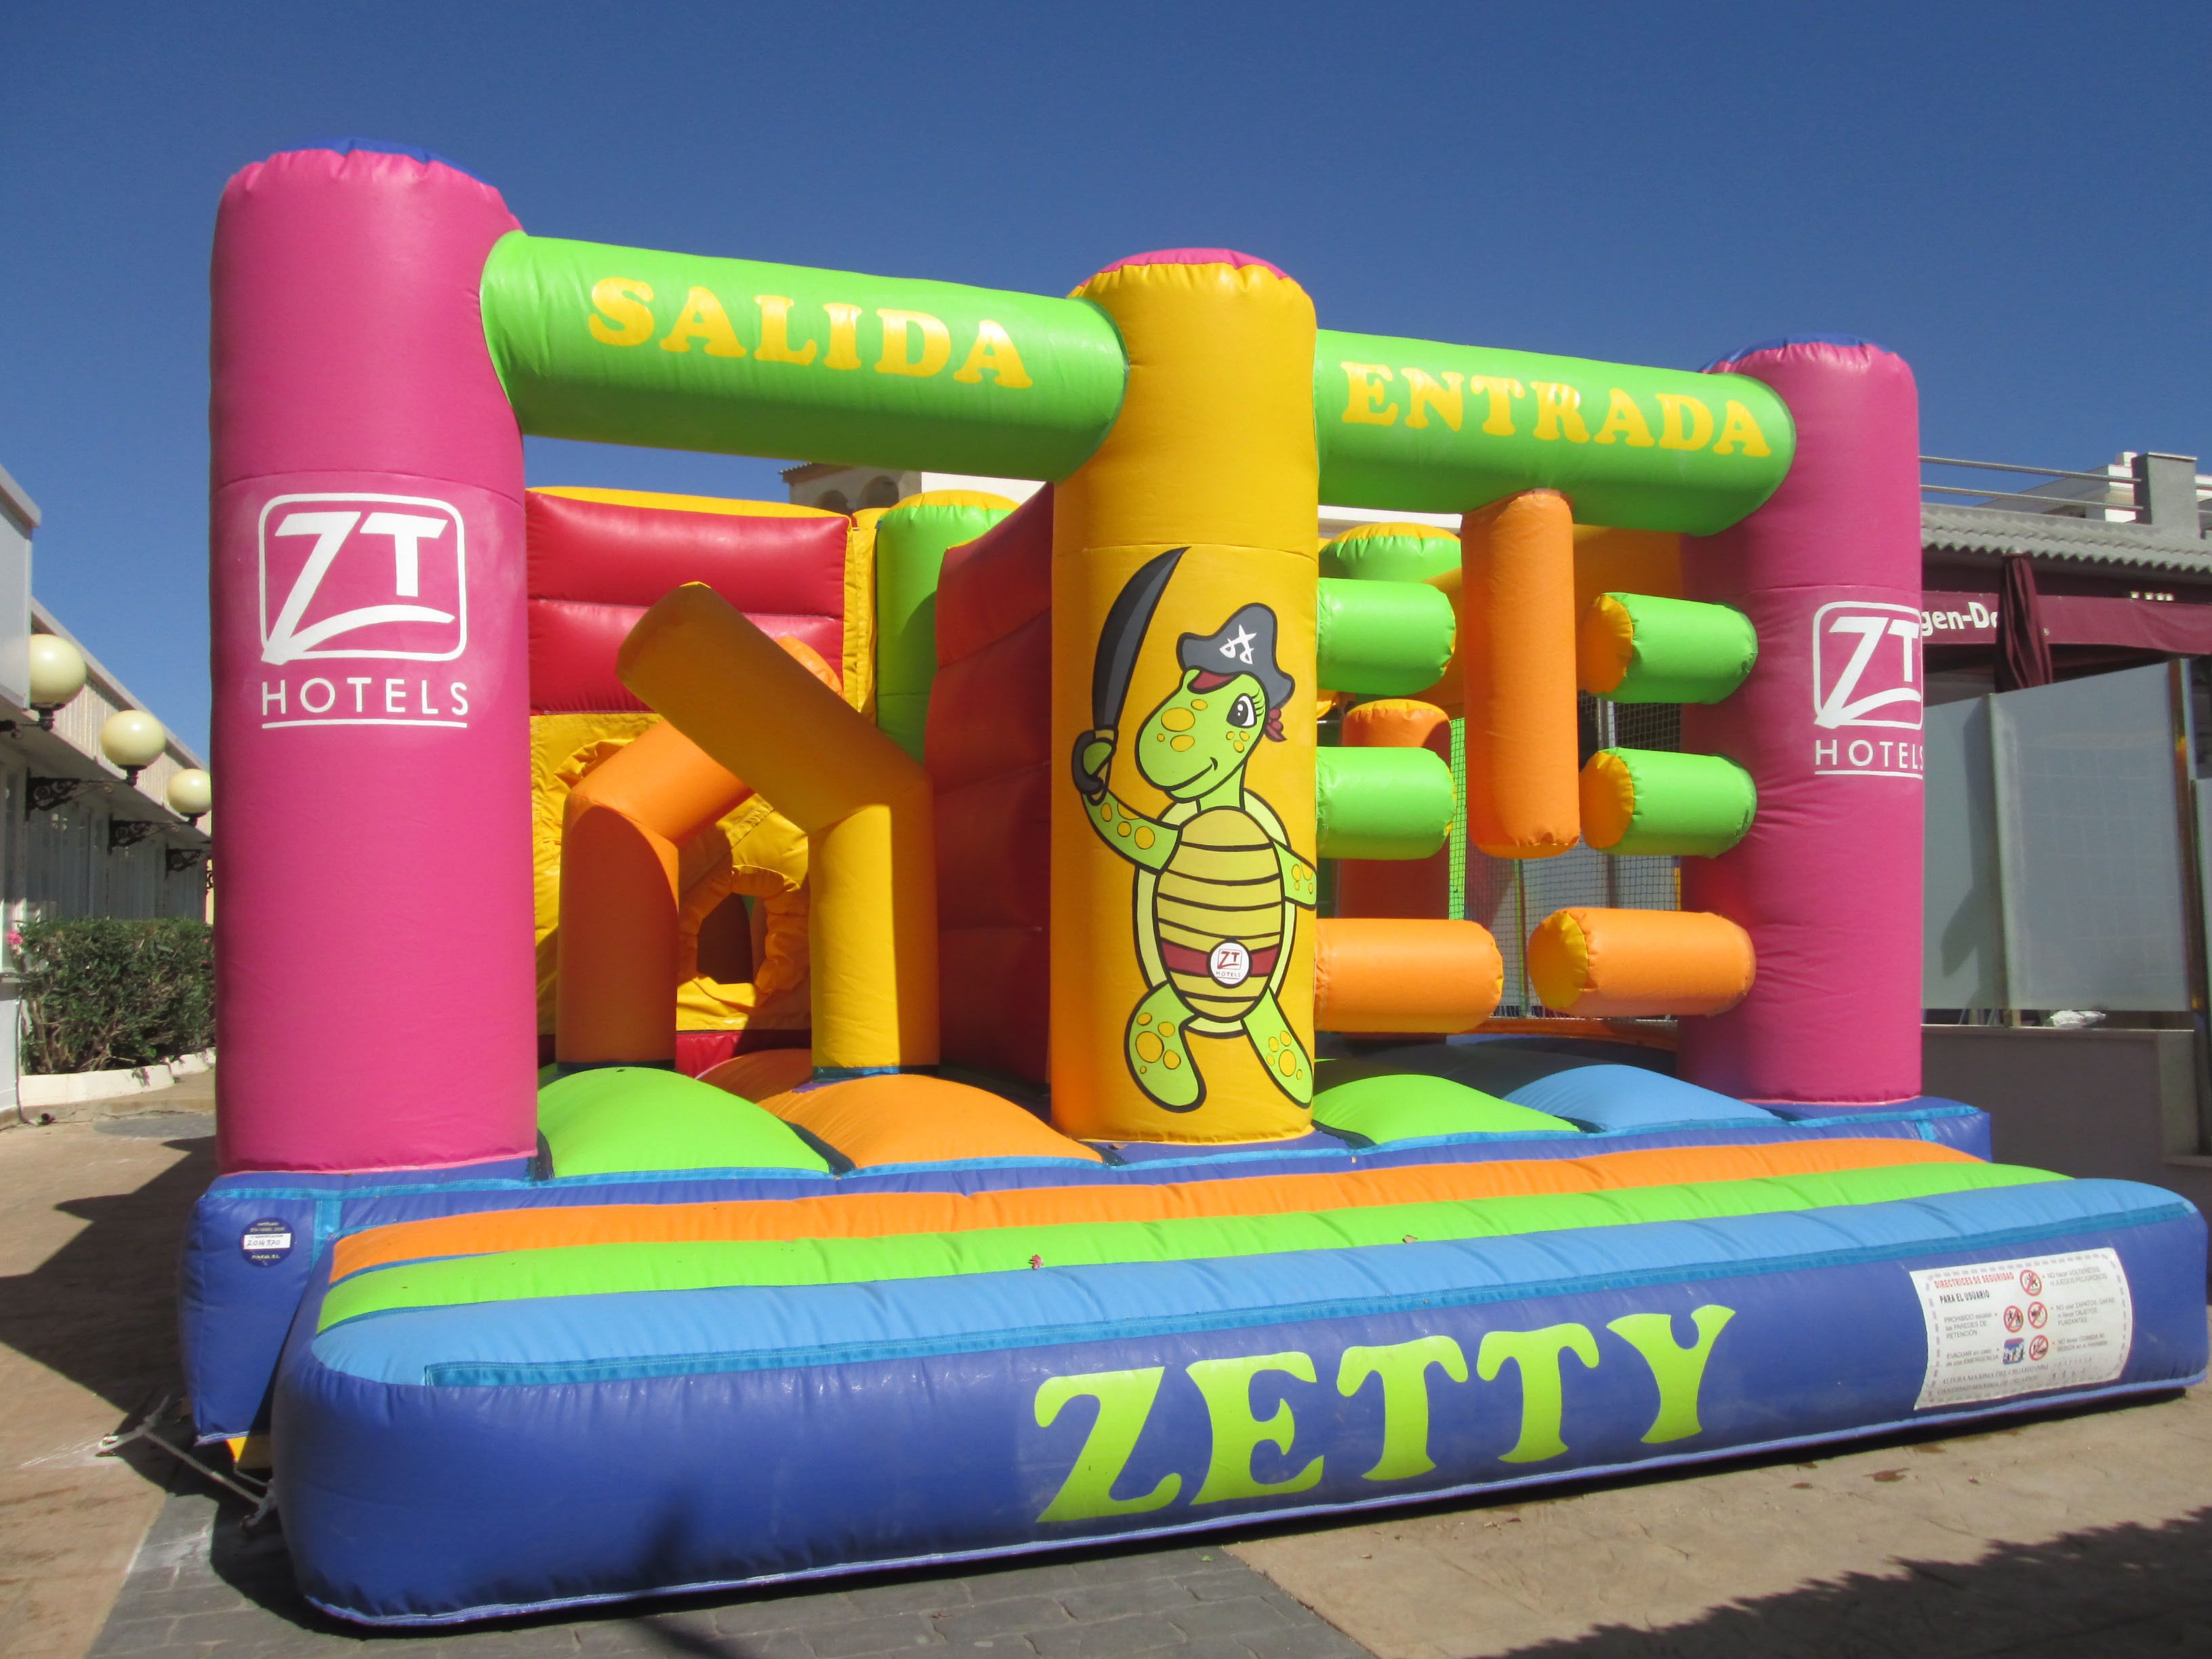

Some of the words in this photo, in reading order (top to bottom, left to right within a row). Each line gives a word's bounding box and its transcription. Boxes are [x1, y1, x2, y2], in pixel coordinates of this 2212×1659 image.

[588, 276, 1033, 388] SALIDA
[1340, 361, 1771, 457] ENTRADA
[262, 677, 469, 716] HOTELS
[1934, 1277, 1973, 1288] DIRECTRICES
[1973, 1275, 1982, 1284] DE
[1982, 1271, 2014, 1283] SEGURIDAD
[1940, 1294, 1955, 1304] PARA
[1956, 1293, 1964, 1302] EL
[1964, 1290, 1990, 1300] USUARIO
[1033, 1304, 1736, 1523] ZETTY
